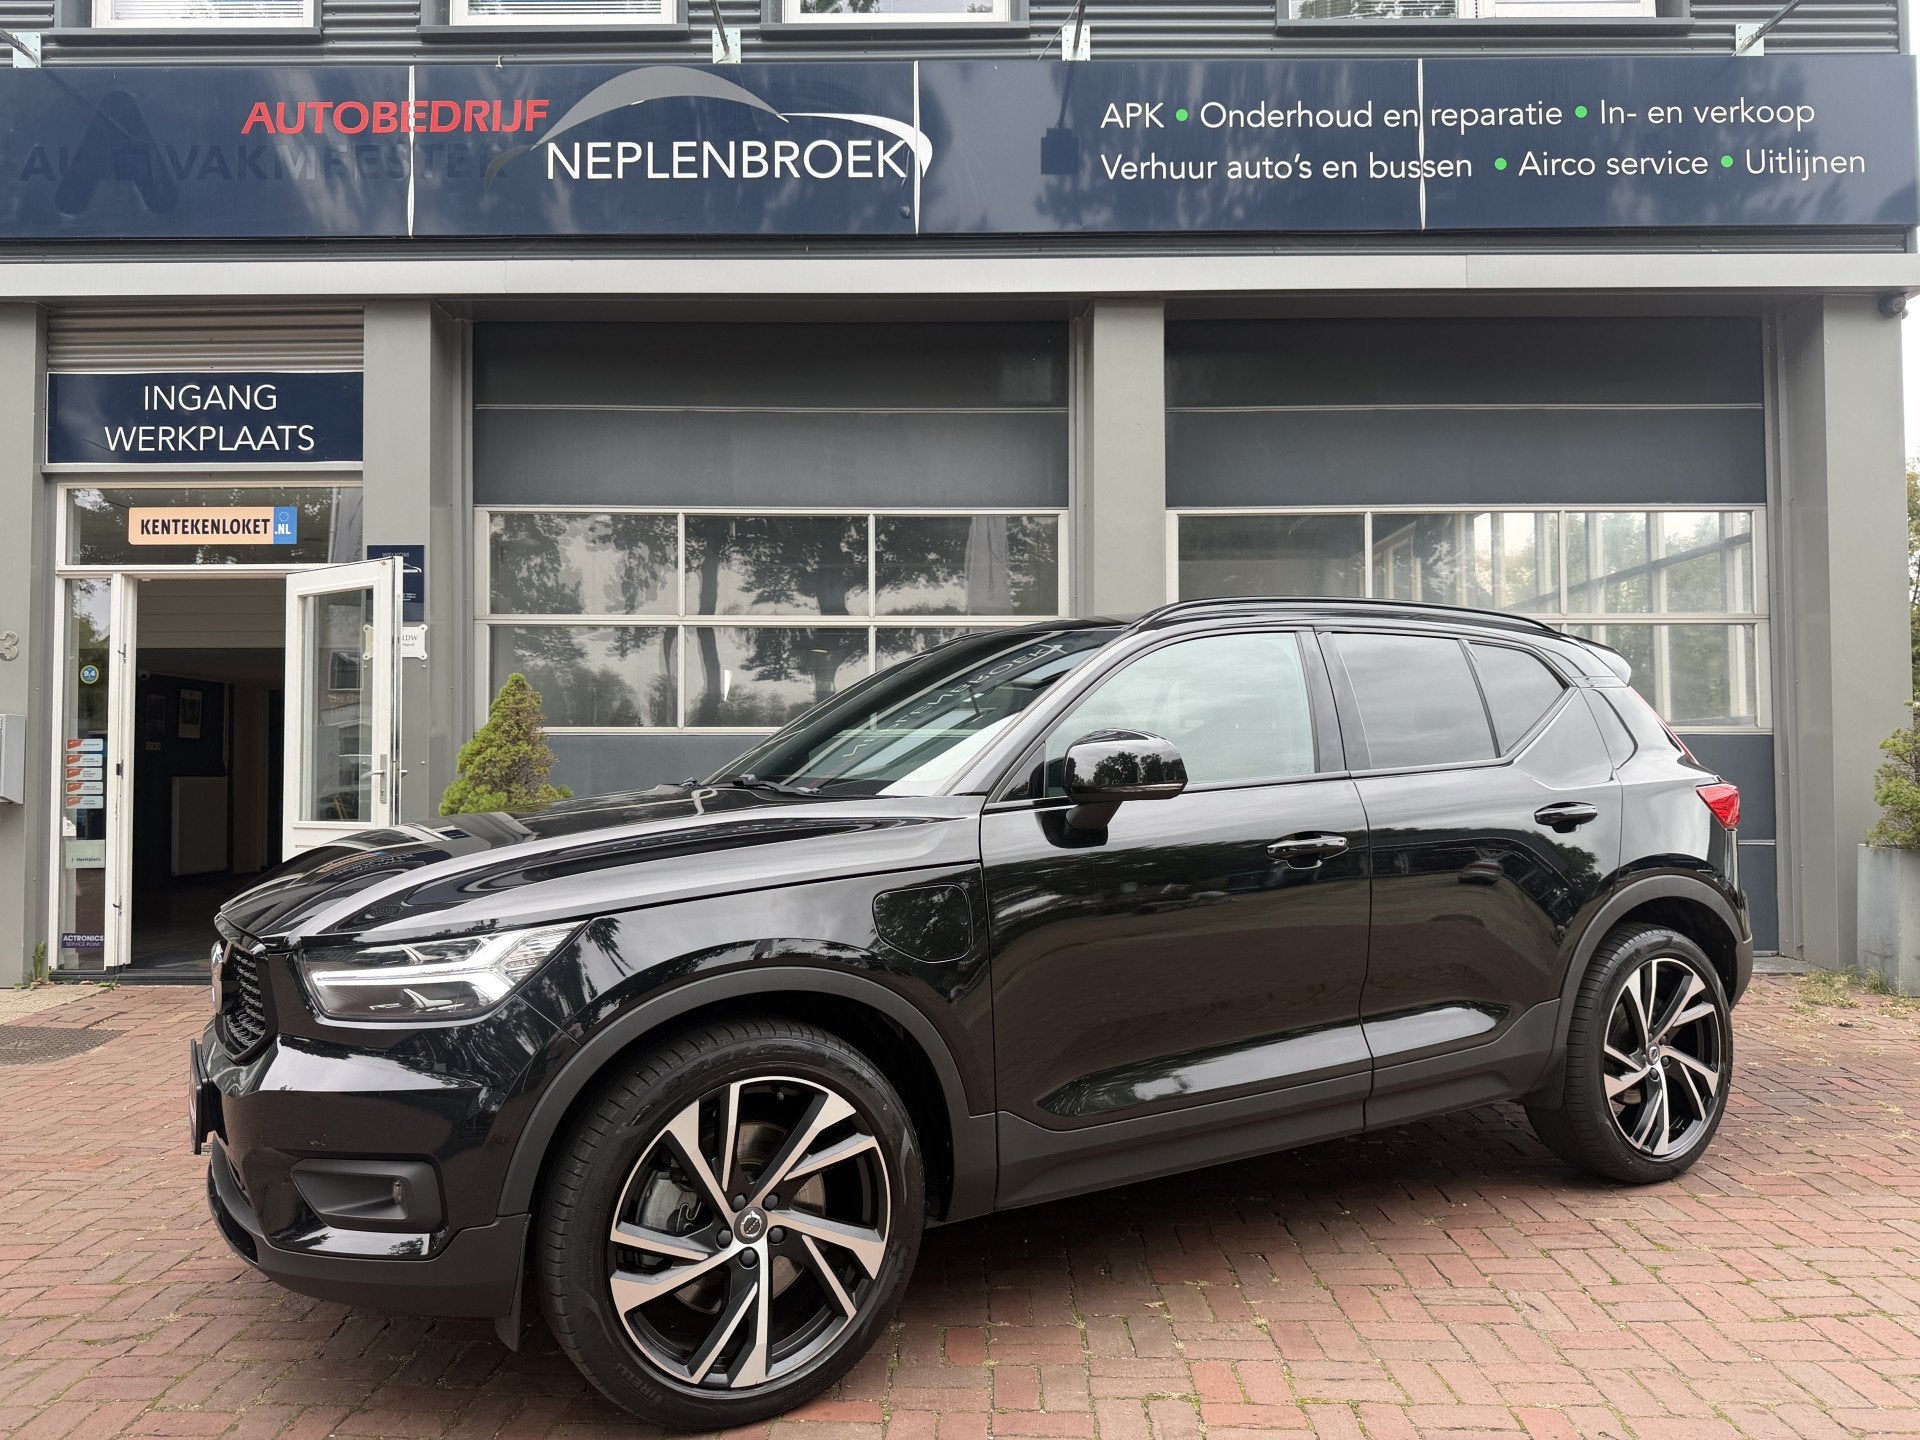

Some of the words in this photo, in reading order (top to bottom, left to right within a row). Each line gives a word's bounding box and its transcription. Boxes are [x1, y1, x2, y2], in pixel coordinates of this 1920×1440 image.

[242, 99, 549, 135] AUTOBEDRIJF
[1100, 102, 1164, 129] APK
[1200, 101, 1372, 129] Onderhoud
[1383, 110, 1418, 128] en
[1431, 101, 1562, 135] reparatie
[1601, 99, 1637, 125] In-
[1647, 106, 1683, 124] en
[1693, 96, 1815, 132] verkoop
[547, 138, 906, 180] NEPLENBROEK
[1100, 153, 1218, 181] Verhuur
[1227, 152, 1312, 180] auto's
[1322, 160, 1357, 179] en
[1369, 151, 1472, 179] bussen
[1518, 151, 1596, 177] Airco
[1606, 151, 1709, 175] service
[1746, 147, 1865, 181] Uitlijnen
[144, 384, 278, 411] INGANG
[104, 424, 315, 452] WERKPLAATS
